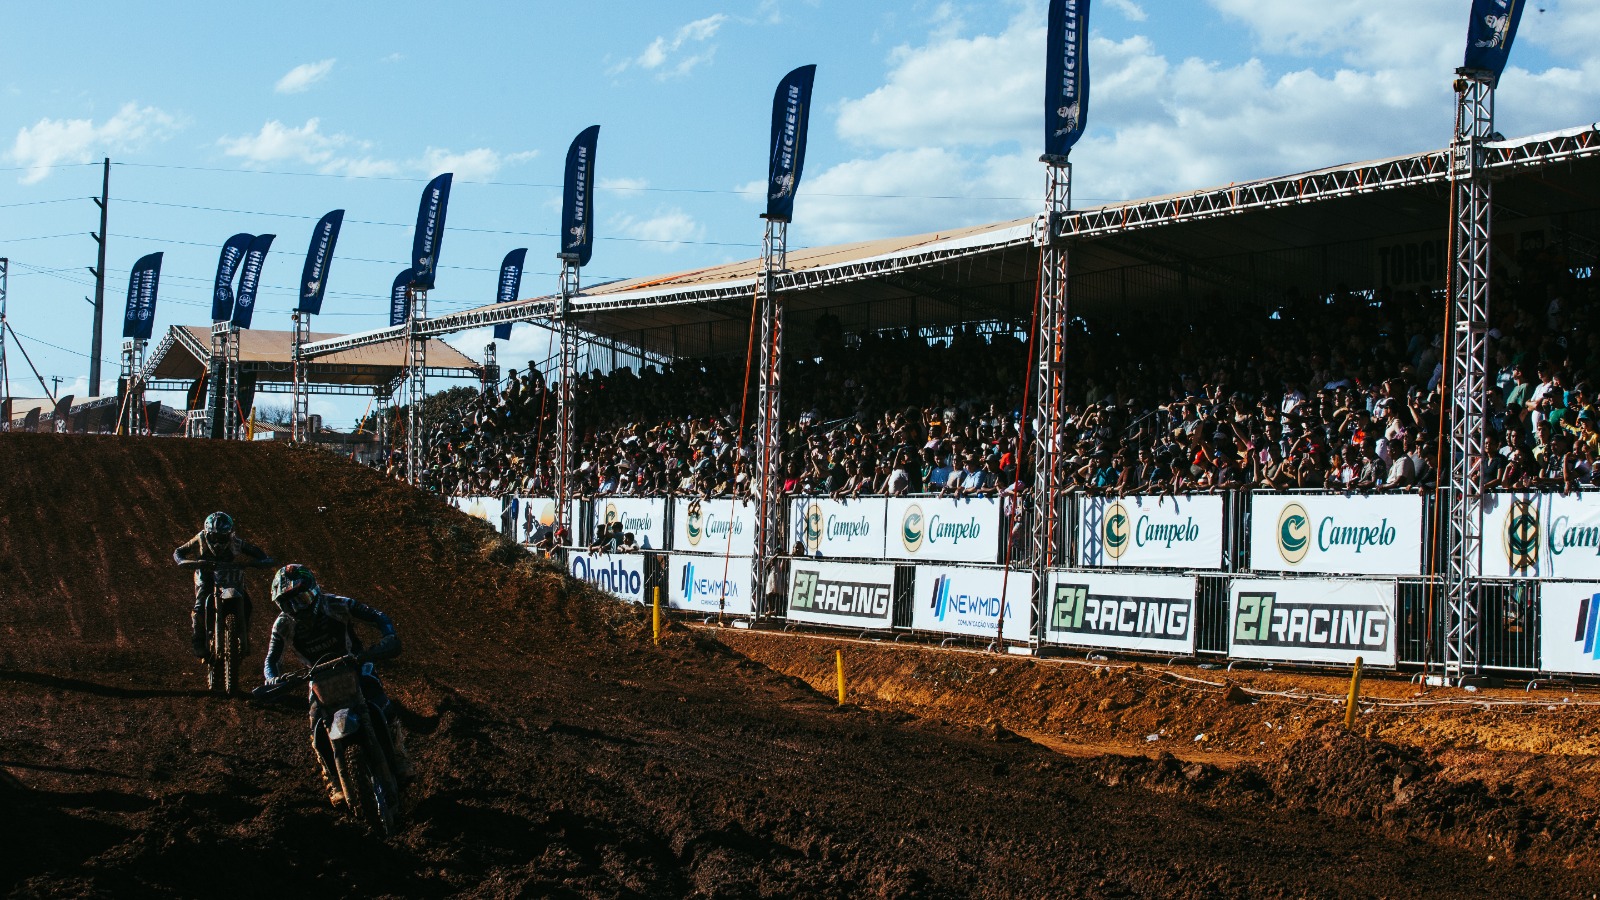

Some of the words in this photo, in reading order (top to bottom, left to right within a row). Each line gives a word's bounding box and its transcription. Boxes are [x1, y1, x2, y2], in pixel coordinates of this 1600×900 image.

[781, 84, 799, 169] MICHELIN
[574, 145, 587, 221] MICHELIN
[423, 188, 440, 253] MICHELIN
[218, 245, 239, 287] YAMAHA
[312, 221, 332, 279] MICHELIN
[139, 269, 154, 308] YAMAHA
[241, 250, 262, 293] YAMAHA
[500, 265, 516, 302] AMAHA
[393, 285, 405, 325] YAMAHA
[705, 513, 743, 540] Campelo
[827, 514, 869, 542] Campelo
[929, 515, 981, 545] Campelo
[1136, 514, 1199, 549] Campelo
[1318, 516, 1396, 553] Campelo
[1549, 515, 1600, 556] Cam
